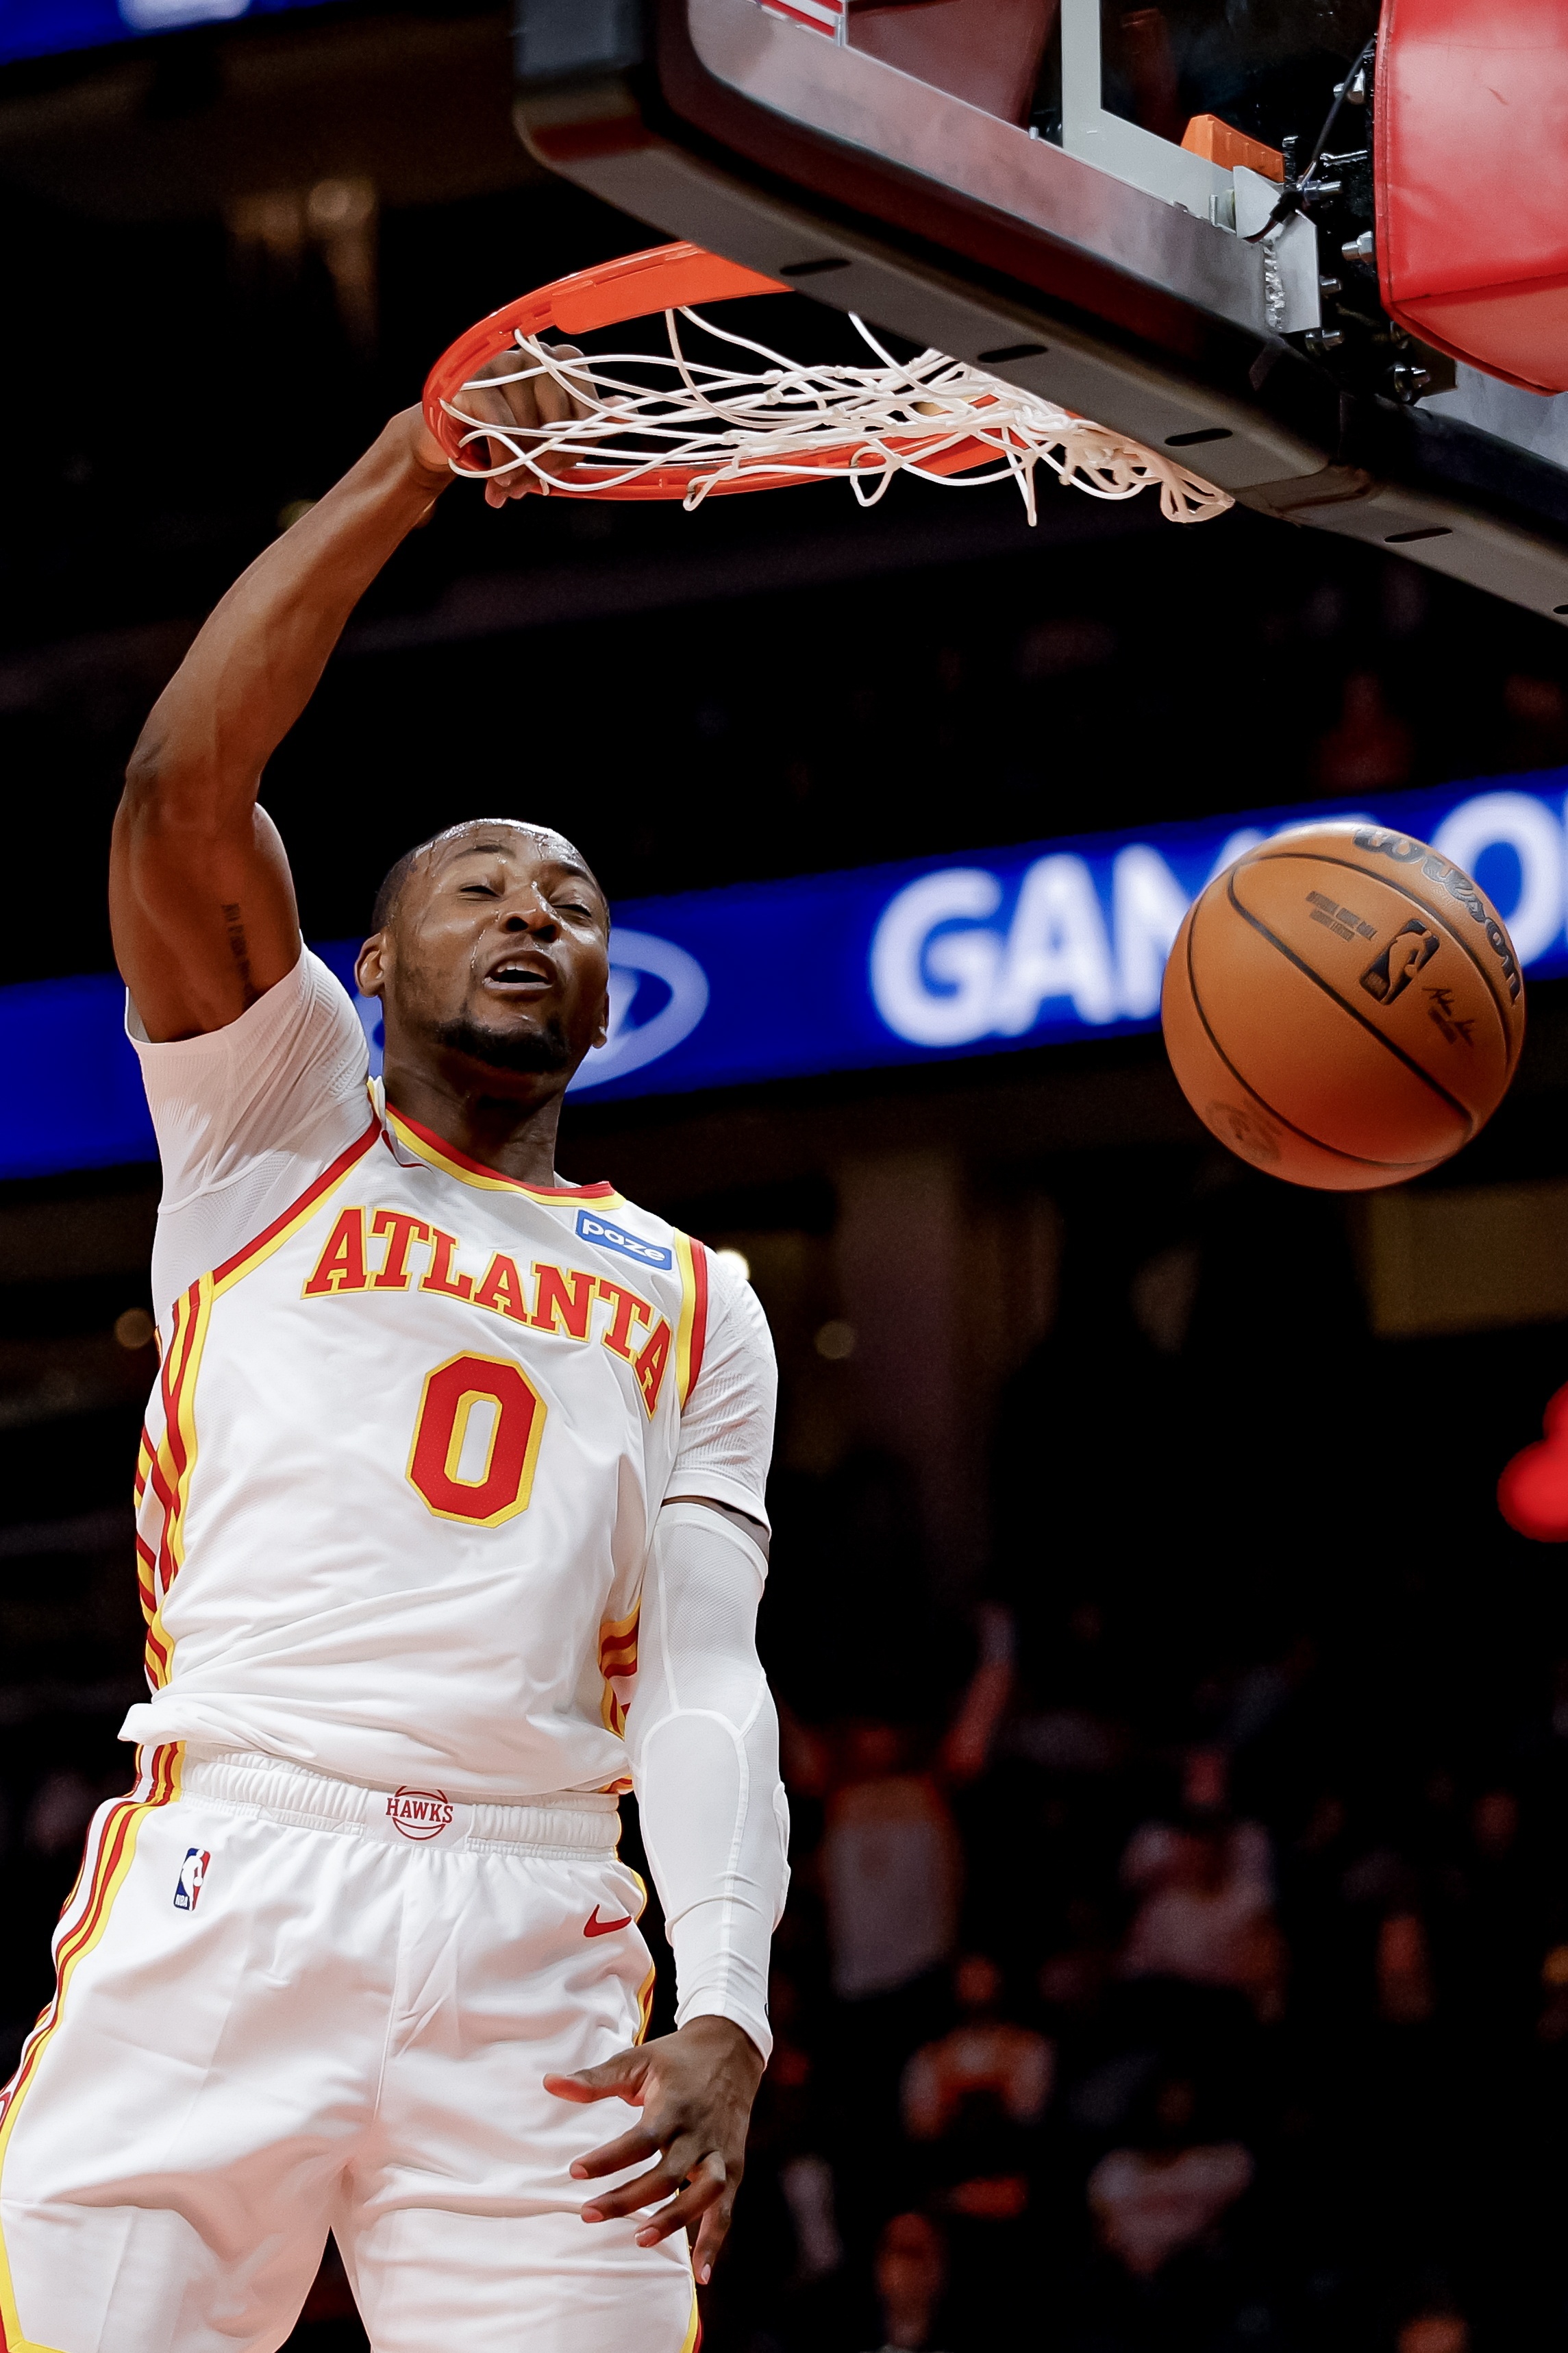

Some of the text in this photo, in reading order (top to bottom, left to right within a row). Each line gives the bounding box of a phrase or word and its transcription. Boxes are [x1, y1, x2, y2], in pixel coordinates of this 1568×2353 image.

[870, 813, 1384, 1050] GAM
[300, 1205, 673, 1421] ATLANTA
[582, 1218, 667, 1262] paze
[404, 1349, 548, 1529] 0
[385, 1797, 453, 1824] HAWKS
